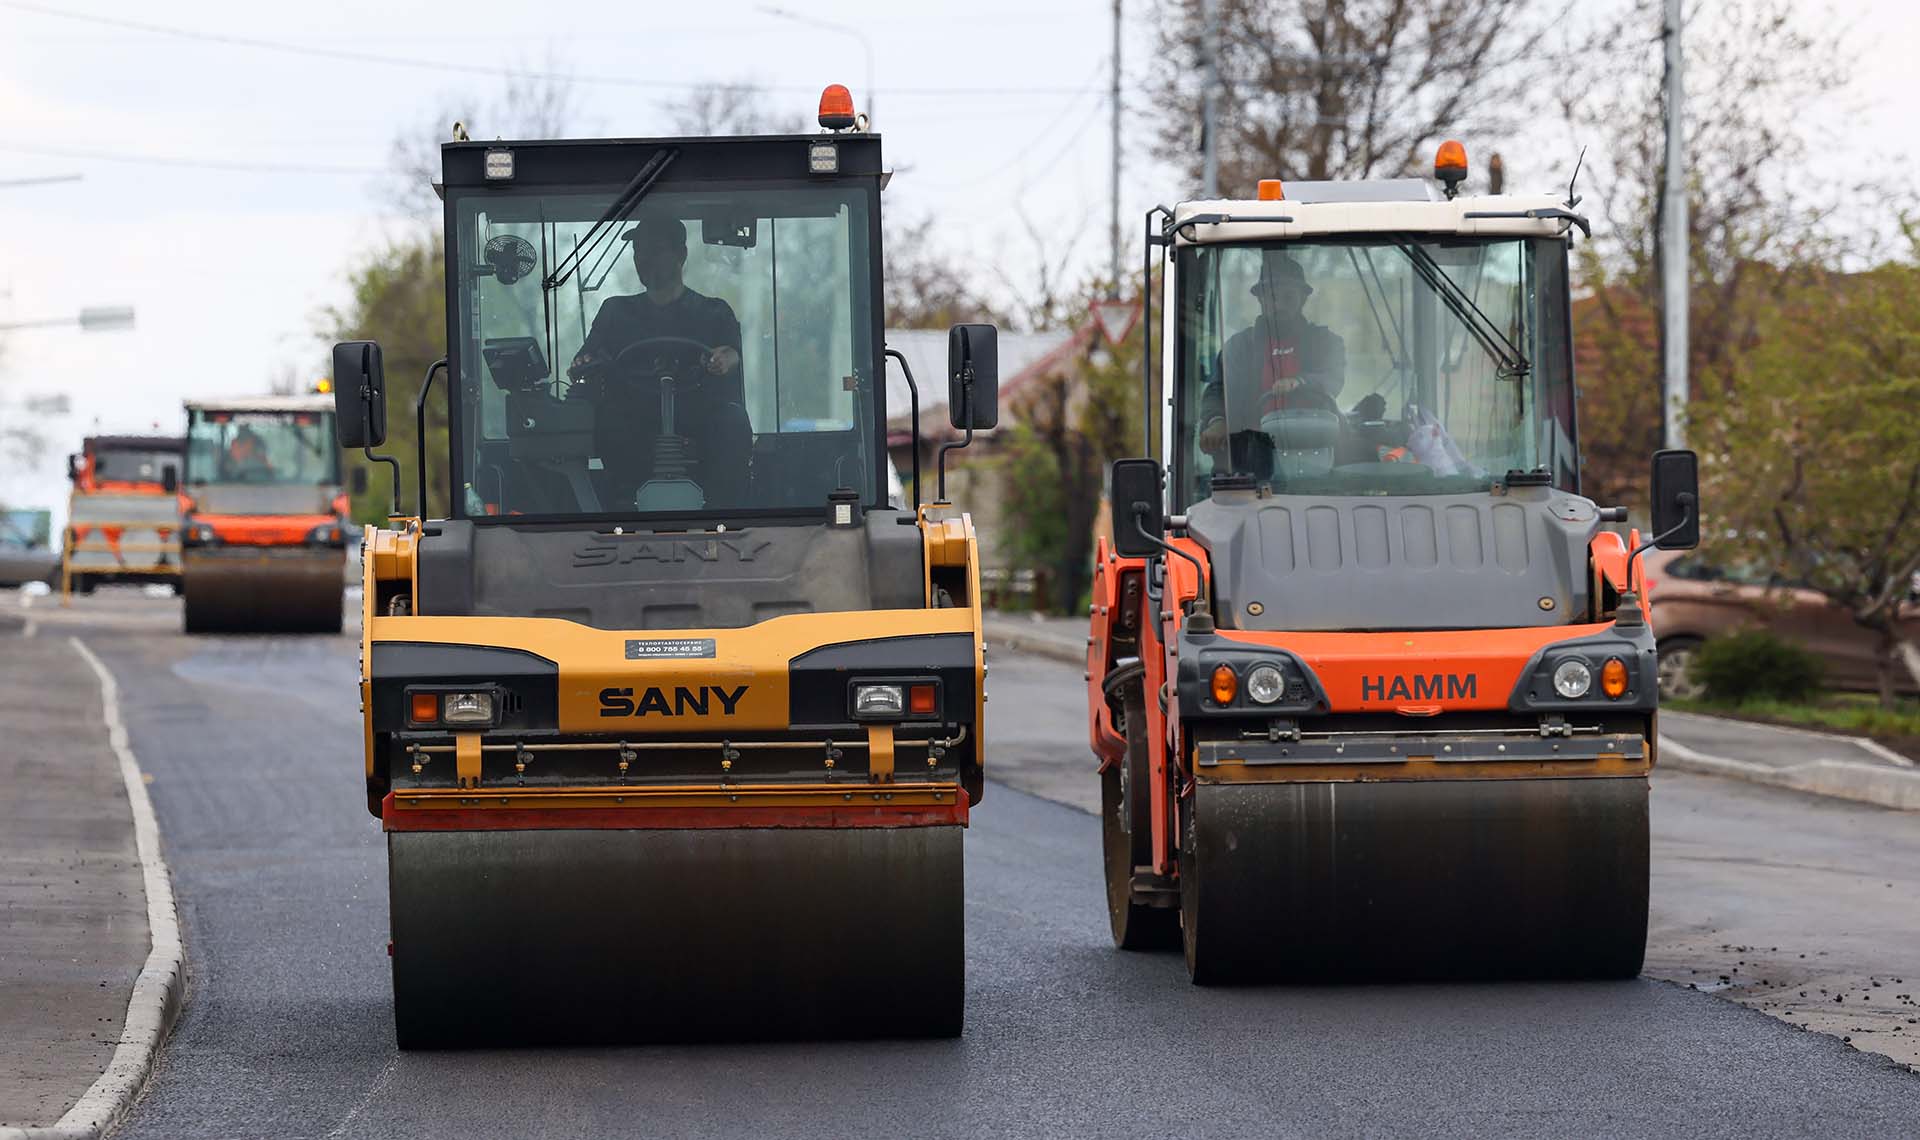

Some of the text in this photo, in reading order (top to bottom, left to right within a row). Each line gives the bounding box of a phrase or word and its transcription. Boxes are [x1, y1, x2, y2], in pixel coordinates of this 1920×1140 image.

[573, 540, 771, 568] SANY
[599, 685, 750, 717] SANY
[1361, 673, 1477, 701] HAMM
